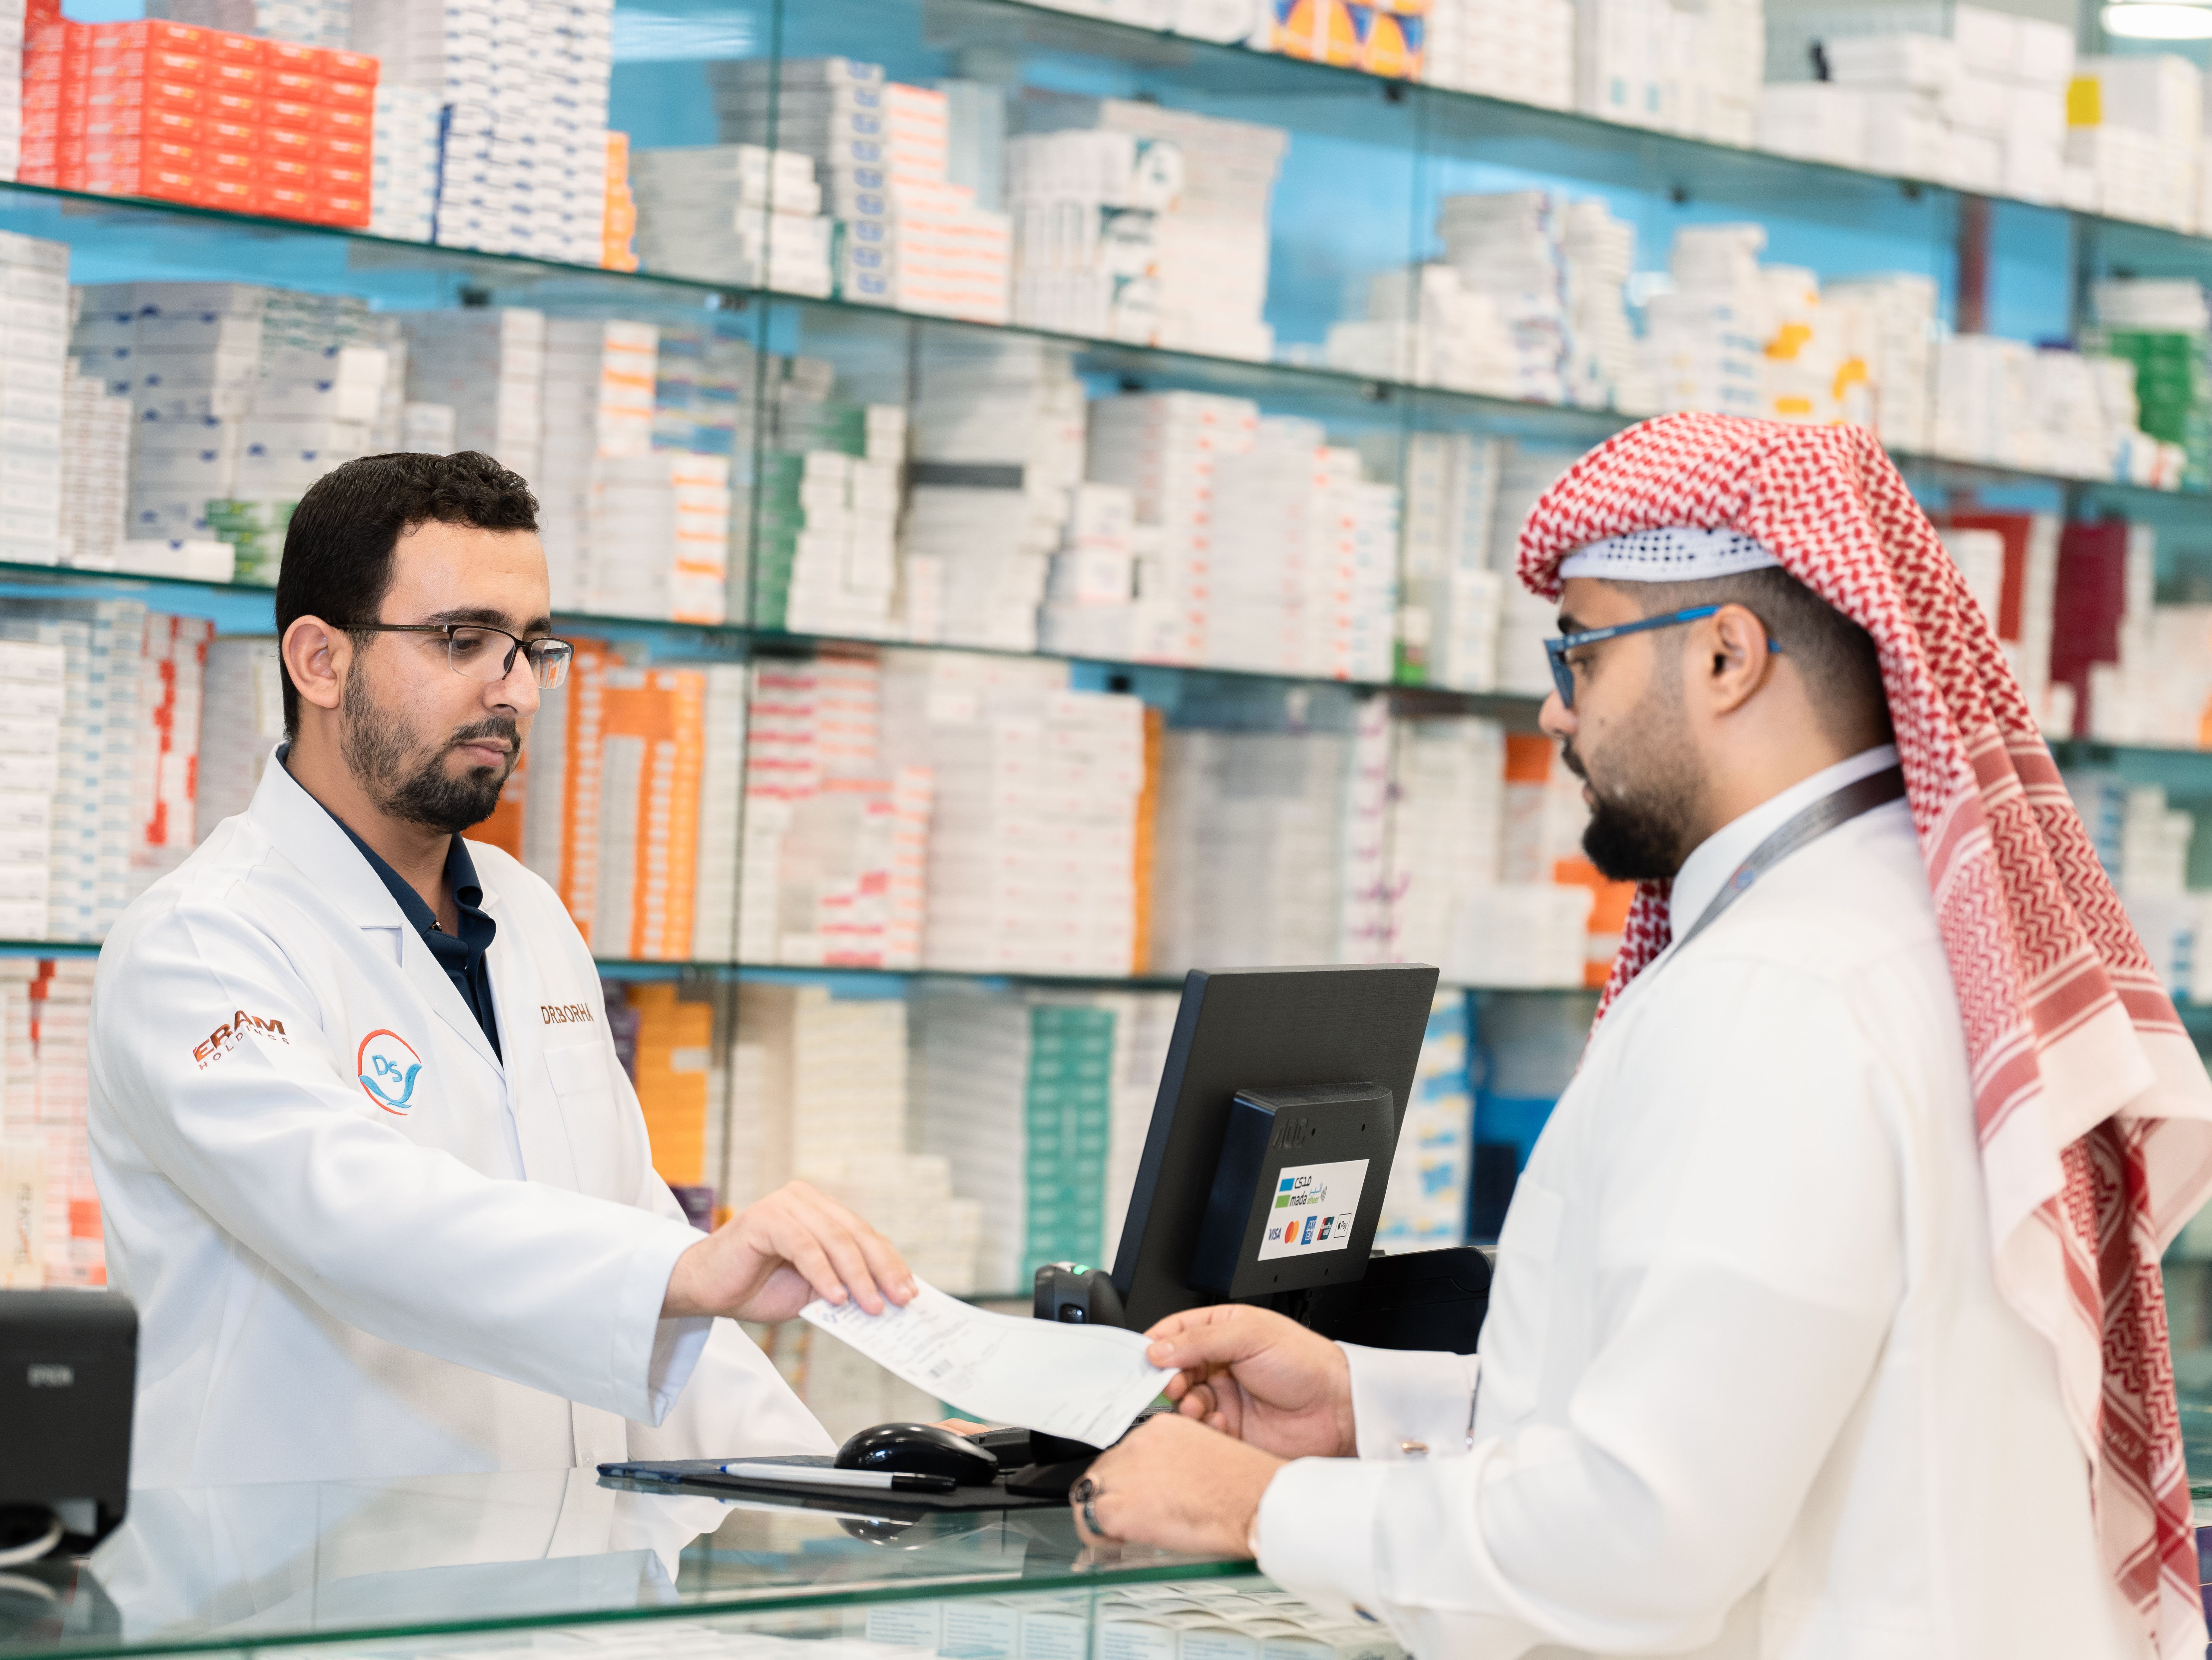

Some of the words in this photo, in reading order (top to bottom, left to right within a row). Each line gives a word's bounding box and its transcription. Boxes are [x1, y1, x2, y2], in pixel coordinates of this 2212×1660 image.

[194, 1010, 286, 1062] ERAM
[1289, 1191, 1307, 1207] mada
[1268, 1228, 1282, 1241] VISA
